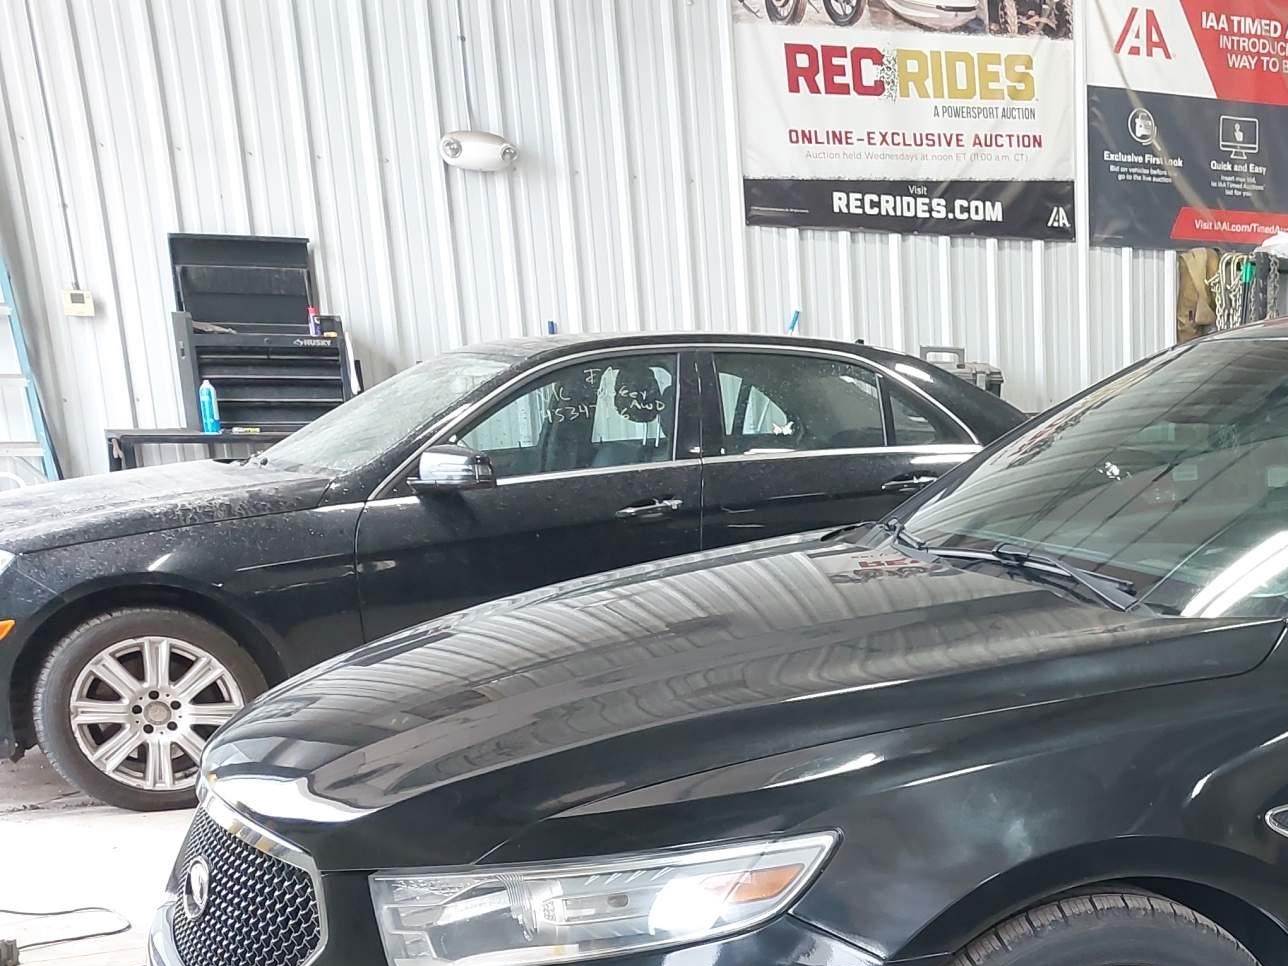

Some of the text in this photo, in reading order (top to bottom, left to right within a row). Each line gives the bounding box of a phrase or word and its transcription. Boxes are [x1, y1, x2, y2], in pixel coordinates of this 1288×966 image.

[1201, 11, 1228, 31] IAA
[1231, 15, 1282, 38] TIMED
[1227, 53, 1257, 70] WAY
[1260, 57, 1280, 73] TO
[934, 106, 1036, 121] A POWERSPORT AUCTION
[788, 129, 1043, 149] ONLINE-EXCLUSIVE AUCTION
[806, 150, 841, 161] Auction
[843, 150, 862, 161] held
[864, 151, 919, 163] Wednesdays
[931, 155, 953, 163] noon
[956, 154, 967, 163] ET
[1103, 150, 1143, 164] Exclusive
[1210, 160, 1267, 176] Quick and Easy
[909, 185, 928, 196] Visit
[832, 191, 1004, 223] RECRIDES.COM
[1194, 219, 1213, 231] Visit
